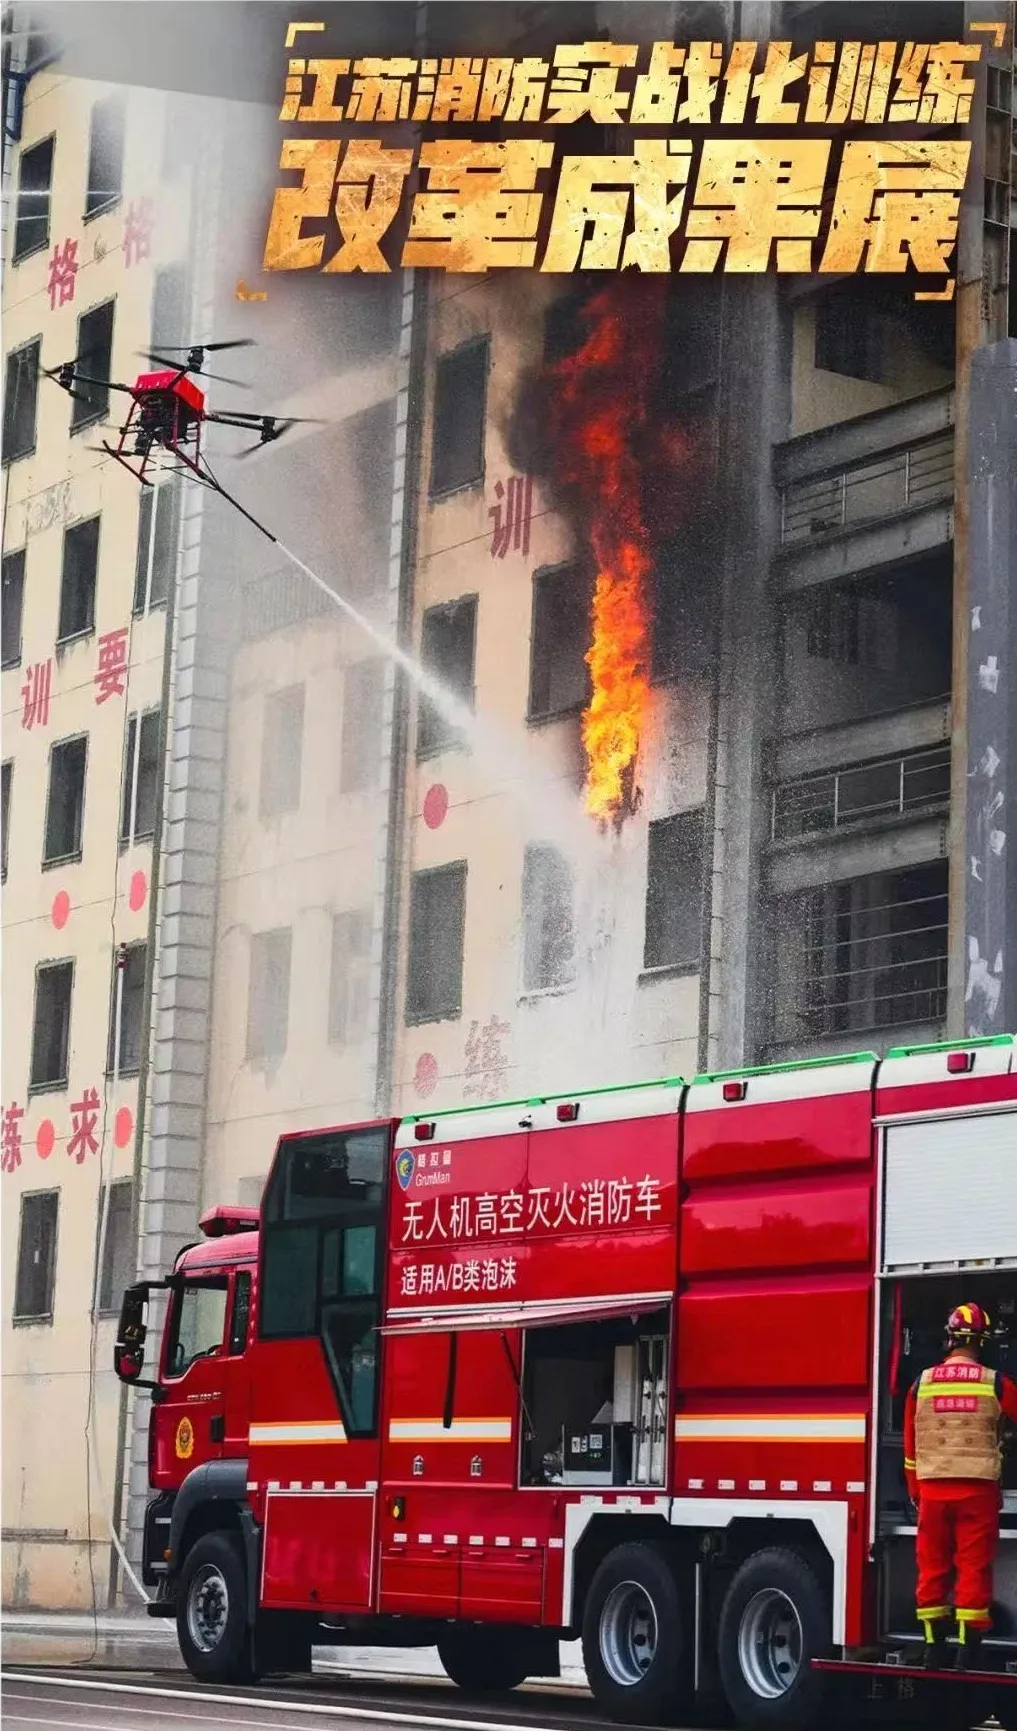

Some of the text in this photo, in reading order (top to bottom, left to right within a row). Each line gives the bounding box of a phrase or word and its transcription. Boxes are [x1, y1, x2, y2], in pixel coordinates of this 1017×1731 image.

[48, 237, 79, 311] 格
[488, 473, 533, 559] 训
[21, 658, 52, 731] 训
[94, 627, 128, 705] 要
[67, 1086, 100, 1164] 求
[402, 1173, 662, 1242] 无人机高空灭火消防车
[401, 1258, 517, 1296] 适用A/B类泡沫
[934, 1366, 979, 1378] 江苏消防
